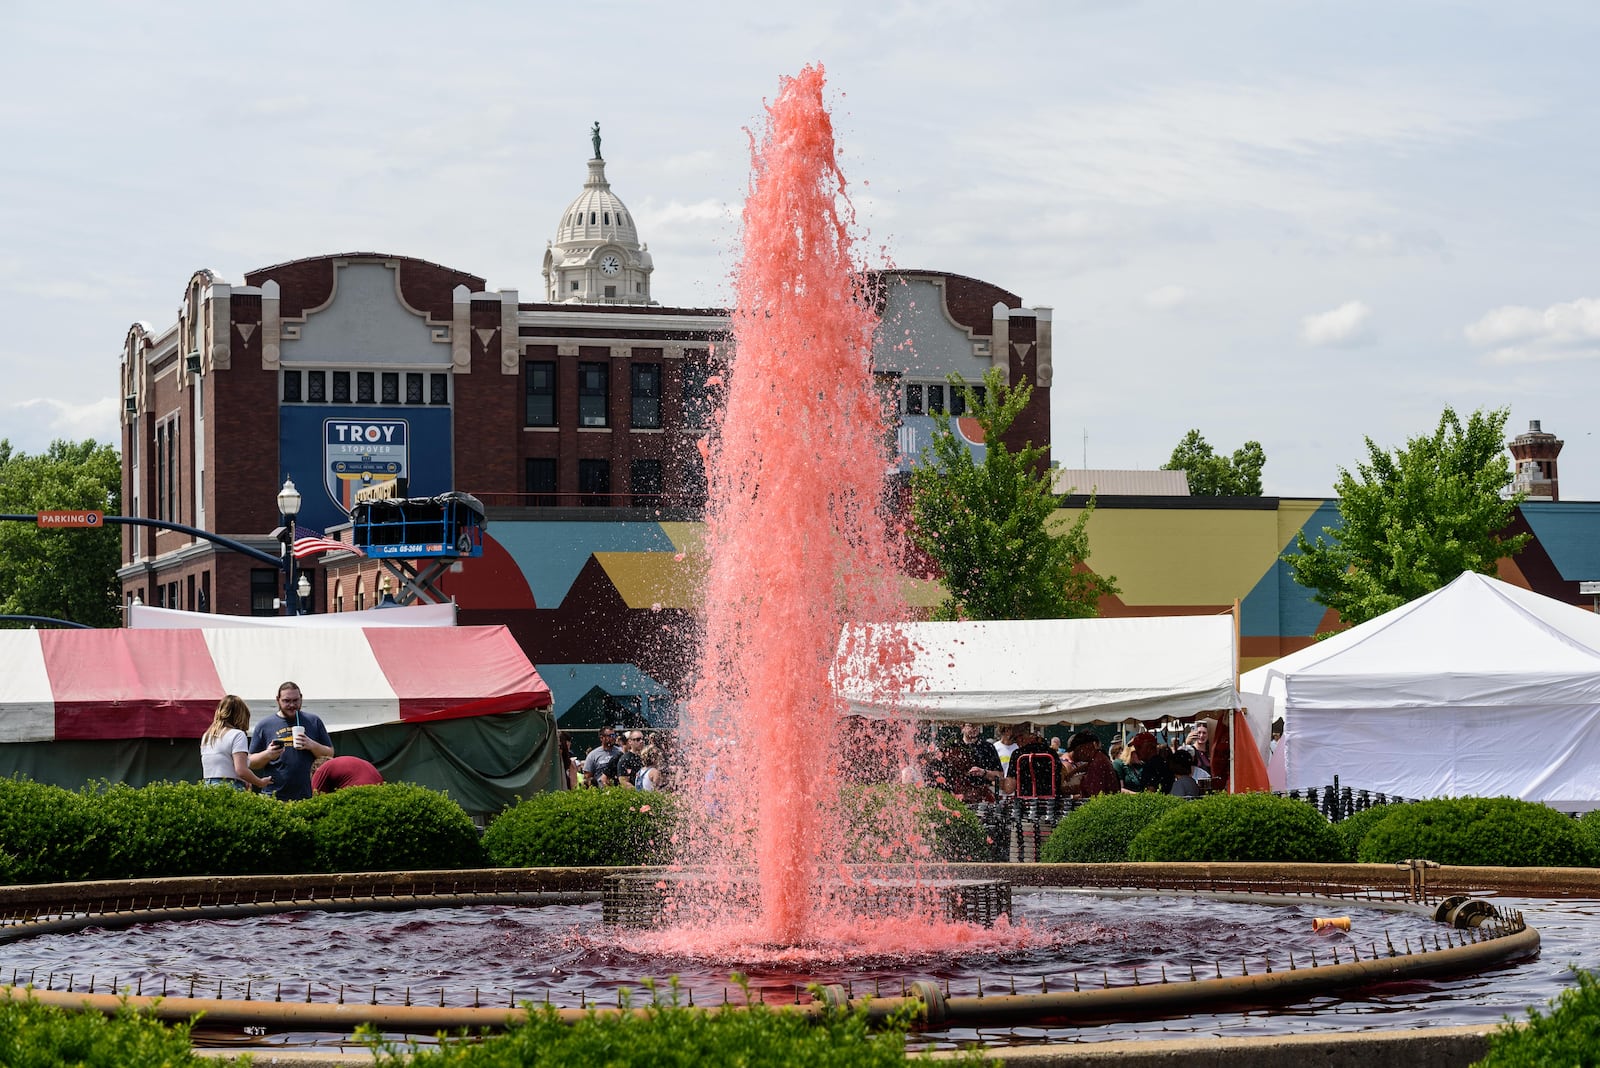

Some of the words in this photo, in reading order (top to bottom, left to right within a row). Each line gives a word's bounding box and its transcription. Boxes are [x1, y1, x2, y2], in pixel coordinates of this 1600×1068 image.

[335, 424, 396, 443] TROY
[341, 445, 391, 453] STOPOVER
[42, 515, 85, 523] PARKING
